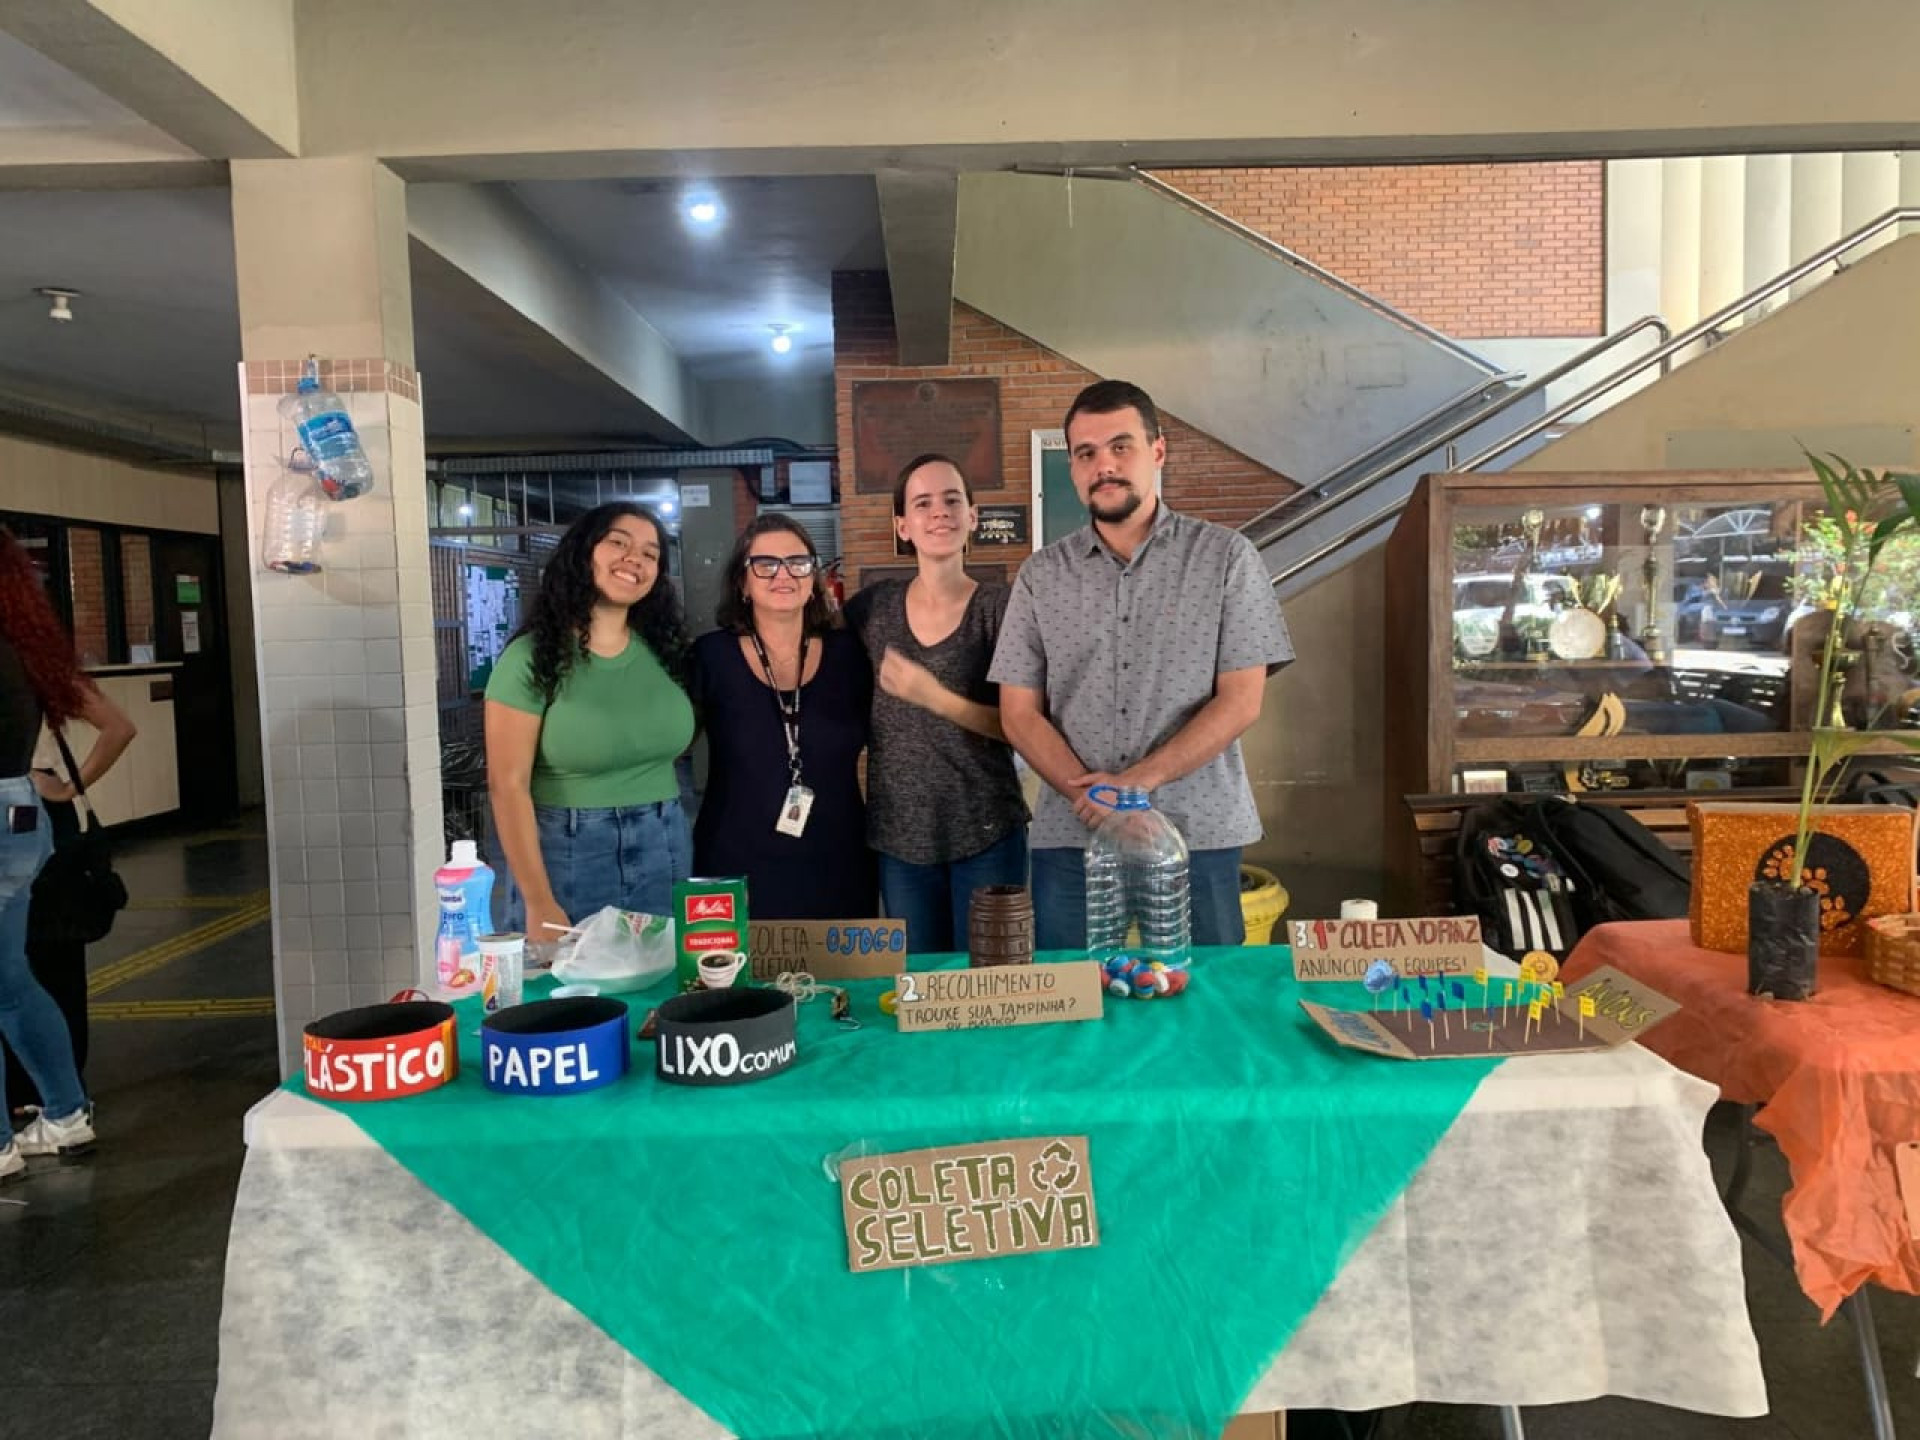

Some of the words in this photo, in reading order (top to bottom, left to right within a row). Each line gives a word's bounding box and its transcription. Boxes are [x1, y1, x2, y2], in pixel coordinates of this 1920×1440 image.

[749, 926, 809, 956] COLETA
[1341, 921, 1406, 950] COLETA
[752, 957, 808, 979] ELETIVA
[926, 970, 1056, 1000] RECOLHIMENTO
[905, 1006, 960, 1024] TROUXE
[968, 1003, 993, 1021] SUA
[488, 1043, 600, 1087] PAPEL
[660, 1033, 740, 1077] LIXO
[740, 1040, 796, 1074] COMUM
[848, 1153, 1017, 1210] COLETA
